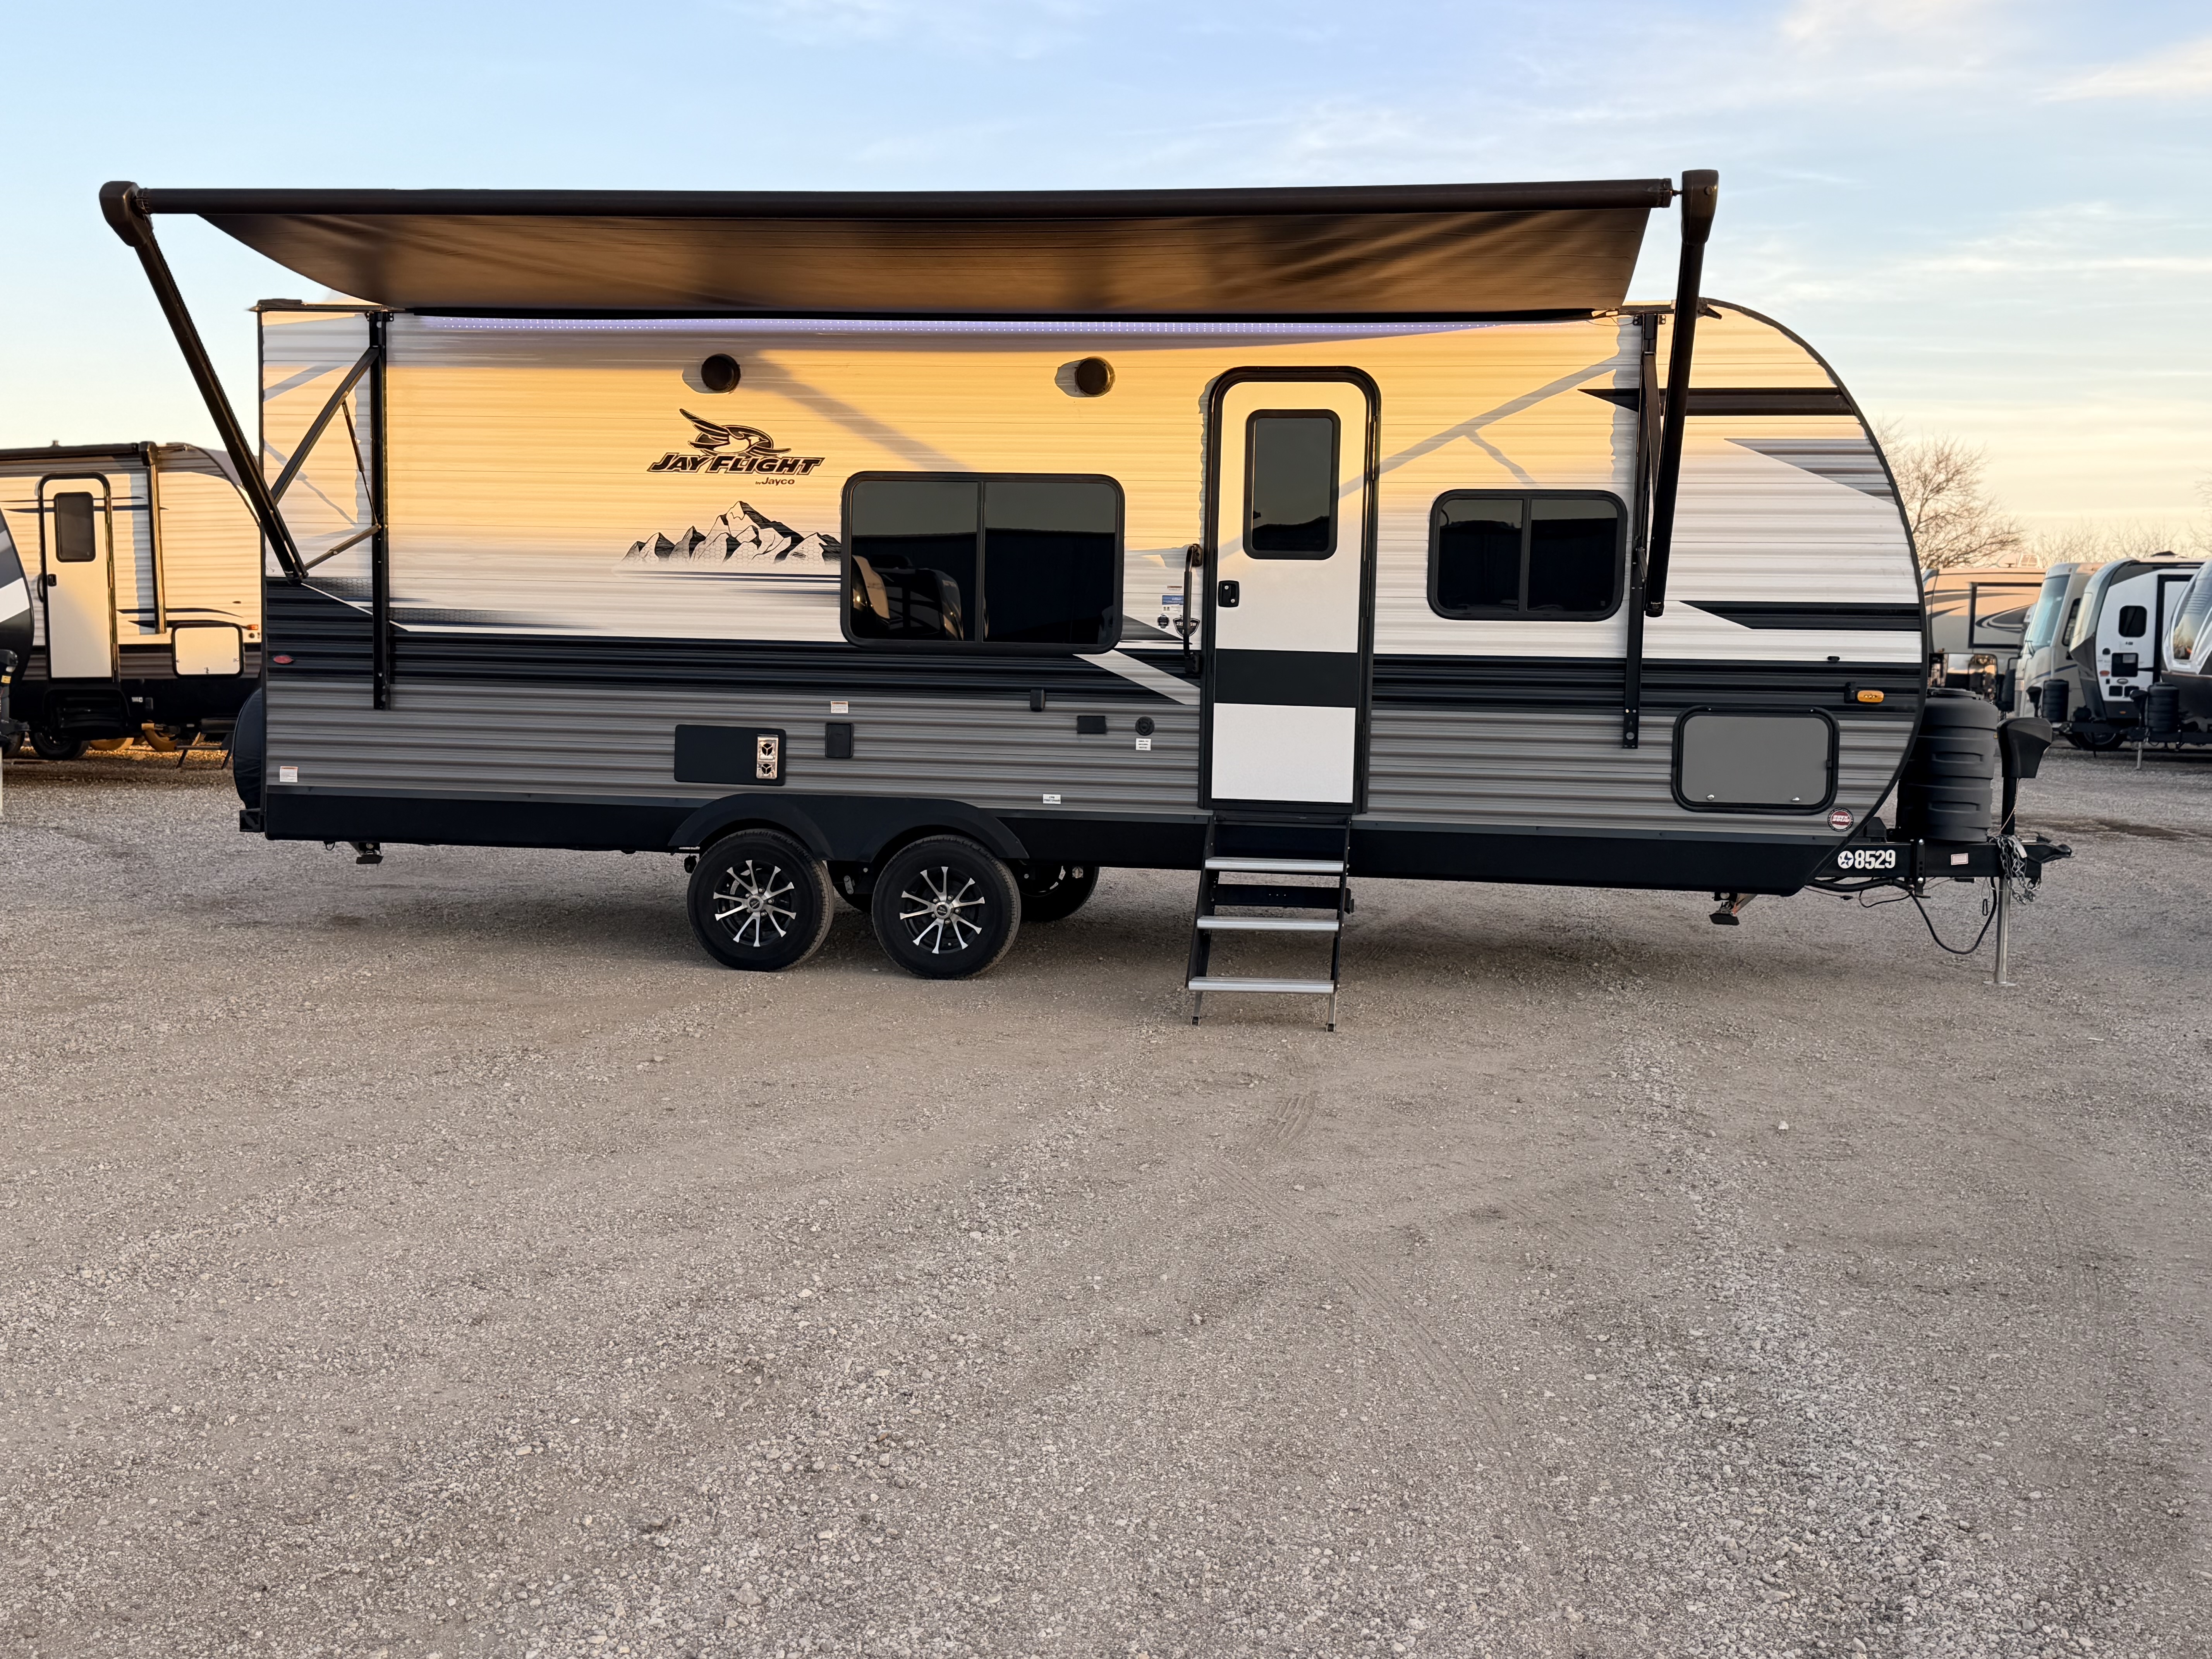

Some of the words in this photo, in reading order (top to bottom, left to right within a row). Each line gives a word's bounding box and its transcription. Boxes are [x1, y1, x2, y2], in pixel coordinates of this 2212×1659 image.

[647, 452, 715, 472] JAY
[705, 456, 825, 475] FLIGHT
[761, 477, 795, 486] Jayco
[1854, 850, 1896, 869] 8529
